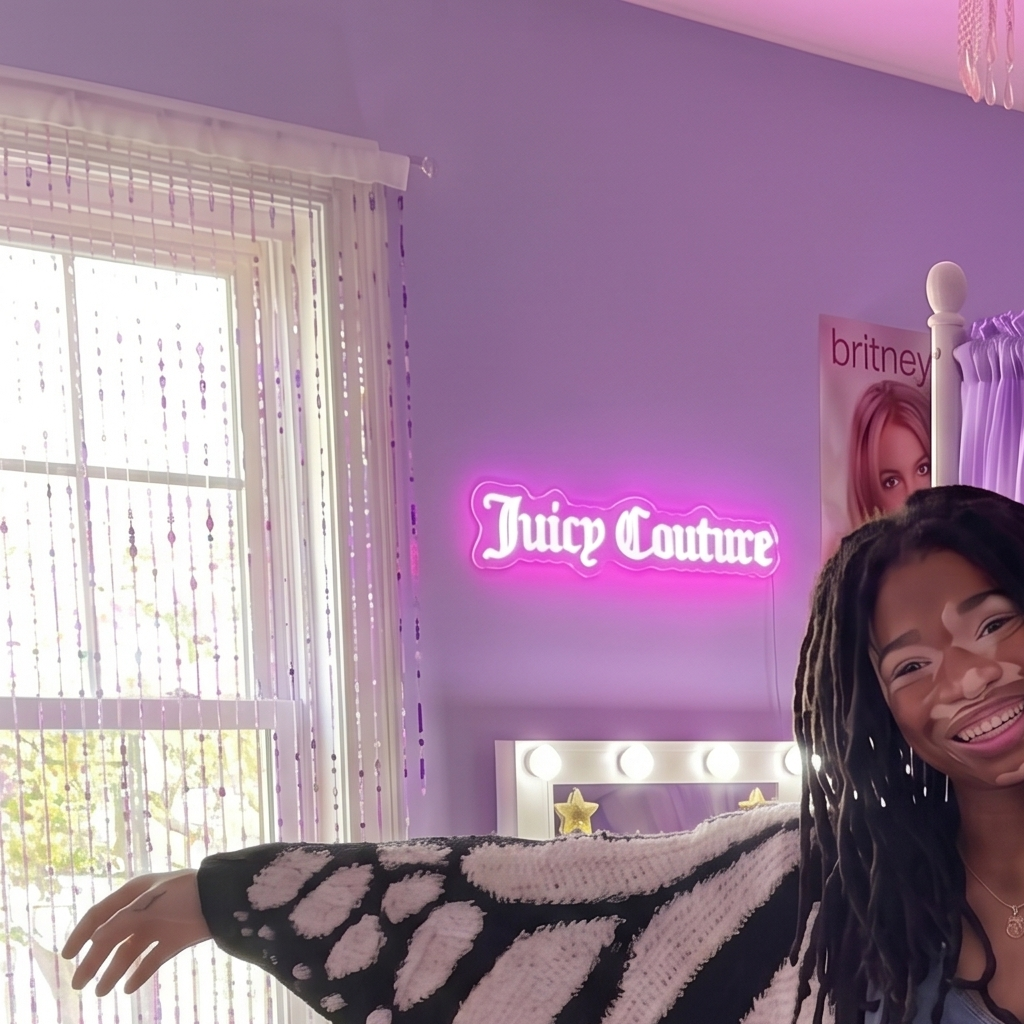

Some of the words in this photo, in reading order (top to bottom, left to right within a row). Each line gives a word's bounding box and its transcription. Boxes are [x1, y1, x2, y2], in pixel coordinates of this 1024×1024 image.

[832, 328, 931, 387] britney
[482, 493, 606, 567] Juicy
[615, 506, 774, 566] Couture
